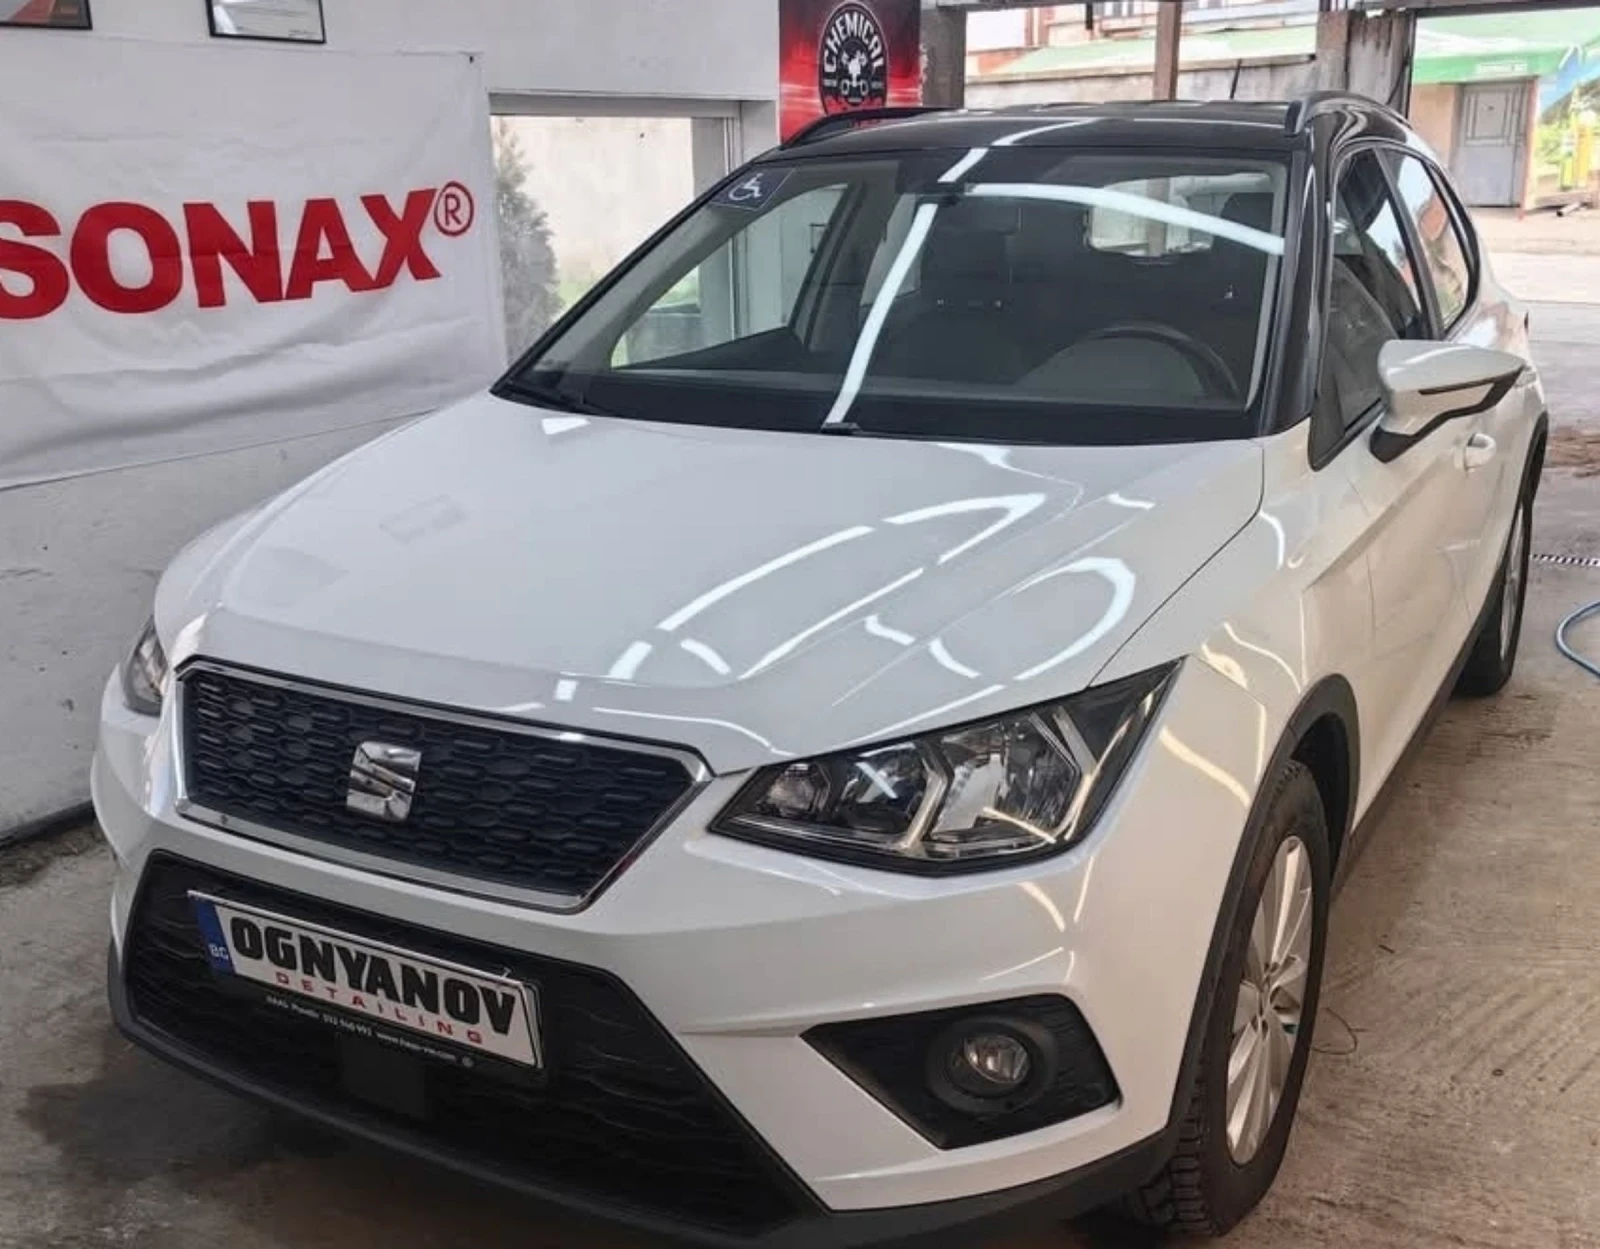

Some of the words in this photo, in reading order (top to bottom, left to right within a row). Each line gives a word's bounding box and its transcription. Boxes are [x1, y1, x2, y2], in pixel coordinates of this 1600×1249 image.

[824, 11, 884, 73] CHEMICAL
[229, 916, 517, 1035] OGNYANOV
[276, 971, 483, 1045] DETAILING
